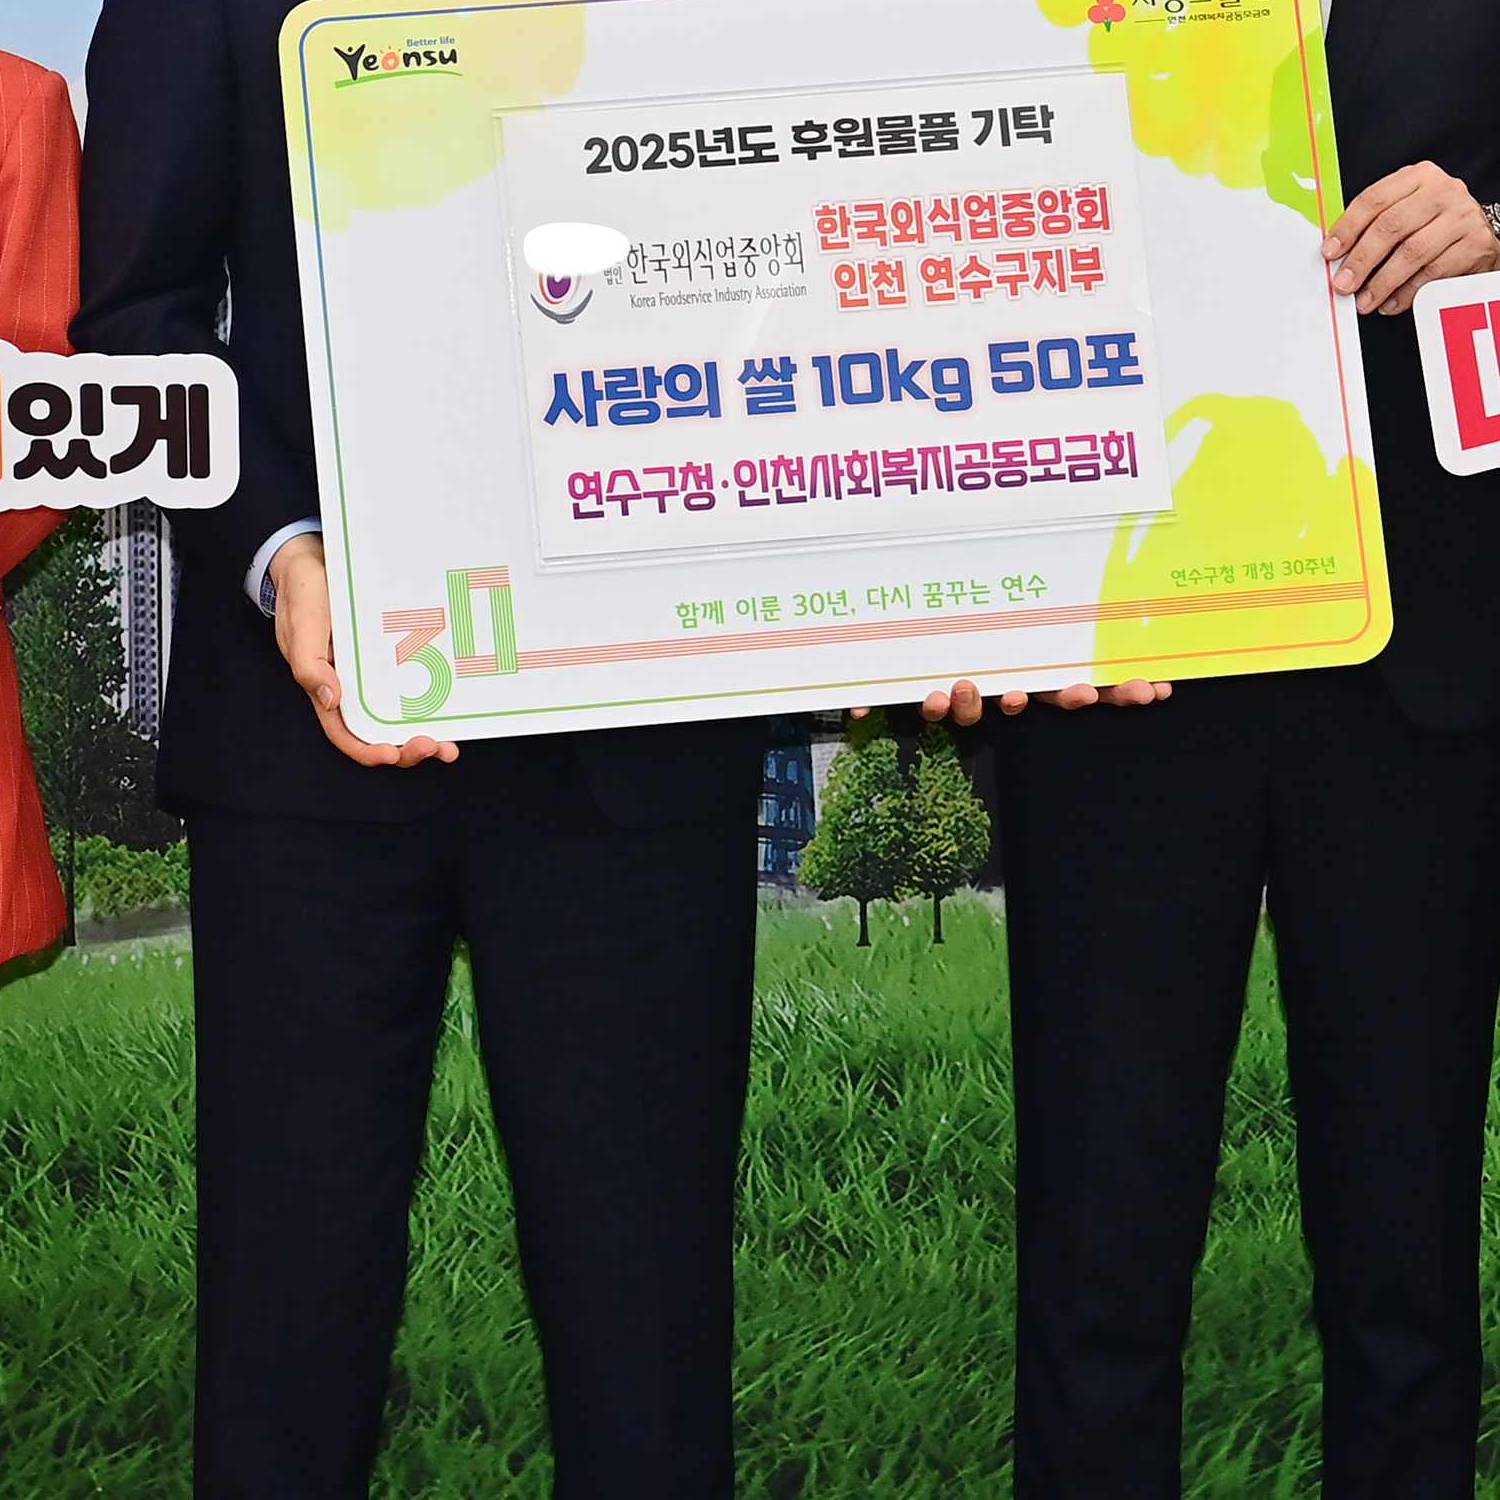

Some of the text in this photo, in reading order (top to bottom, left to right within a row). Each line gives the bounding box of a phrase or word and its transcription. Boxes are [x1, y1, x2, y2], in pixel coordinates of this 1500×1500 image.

[333, 43, 458, 81] Yeonsu
[406, 35, 456, 48] Better life
[583, 104, 1055, 175] 2025년도 후원물품 기탁
[814, 186, 1111, 251] 한국외식업중앙회
[626, 232, 806, 285] 한국외식업중앙회
[833, 247, 1104, 309] 인천 연수구지부
[629, 283, 807, 308] Korea Foodservice Industry Association
[543, 331, 1145, 429] 사랑의 쌀 10kg 50포
[1170, 556, 1337, 588] 연수구청 개청 30주년
[675, 573, 1049, 630] 함께 이룬 30년, 다시 꿈꾸는 연수
